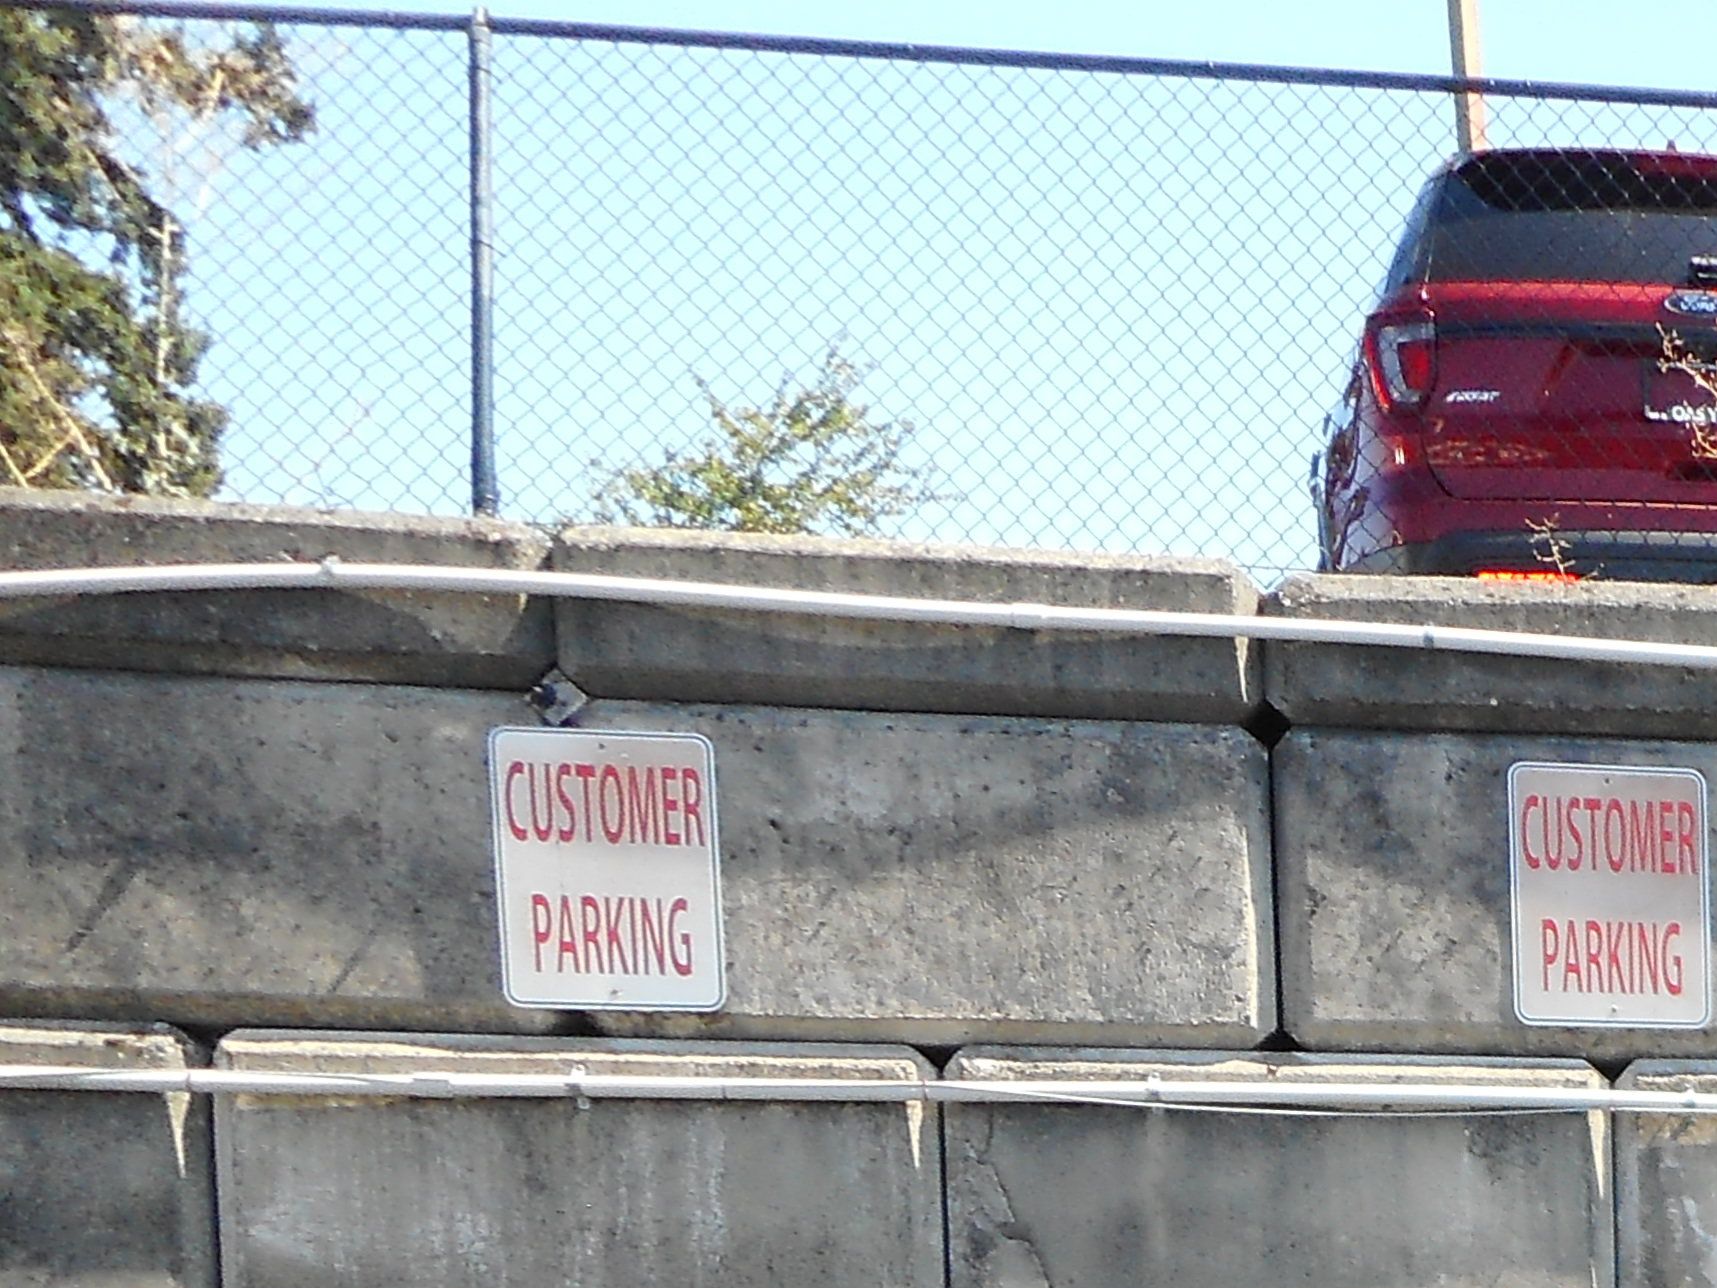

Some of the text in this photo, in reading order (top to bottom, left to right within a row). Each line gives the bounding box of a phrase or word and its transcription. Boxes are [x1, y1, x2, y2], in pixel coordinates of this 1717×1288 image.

[505, 761, 705, 847] CUSTOMER
[1521, 795, 1698, 875] CUSTOMER
[531, 894, 693, 976] PARKING
[1541, 918, 1683, 996] PARKING
